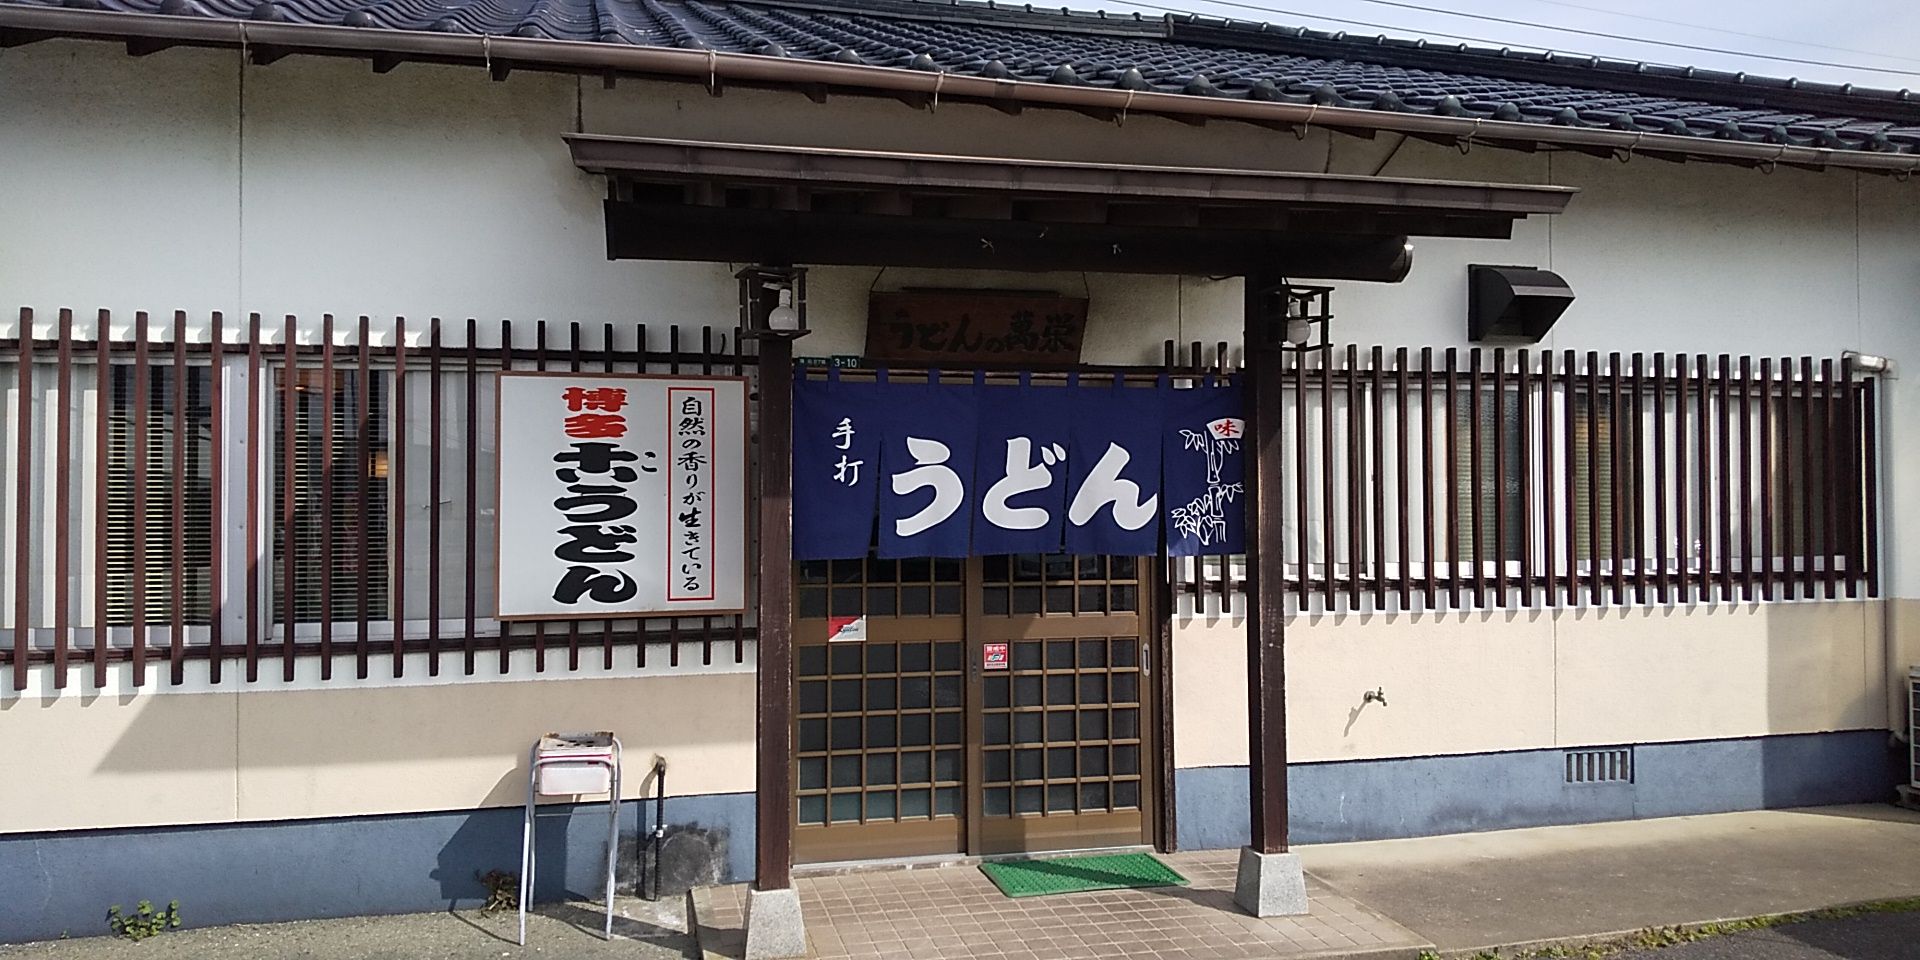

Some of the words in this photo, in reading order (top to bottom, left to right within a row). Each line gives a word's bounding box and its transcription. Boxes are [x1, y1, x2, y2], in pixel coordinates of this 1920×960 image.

[833, 358, 858, 368] 3-10
[831, 417, 863, 487] 手打
[1214, 418, 1240, 437] 味
[677, 397, 708, 591] 自然の香りが生きている
[891, 436, 1158, 537] うどん
